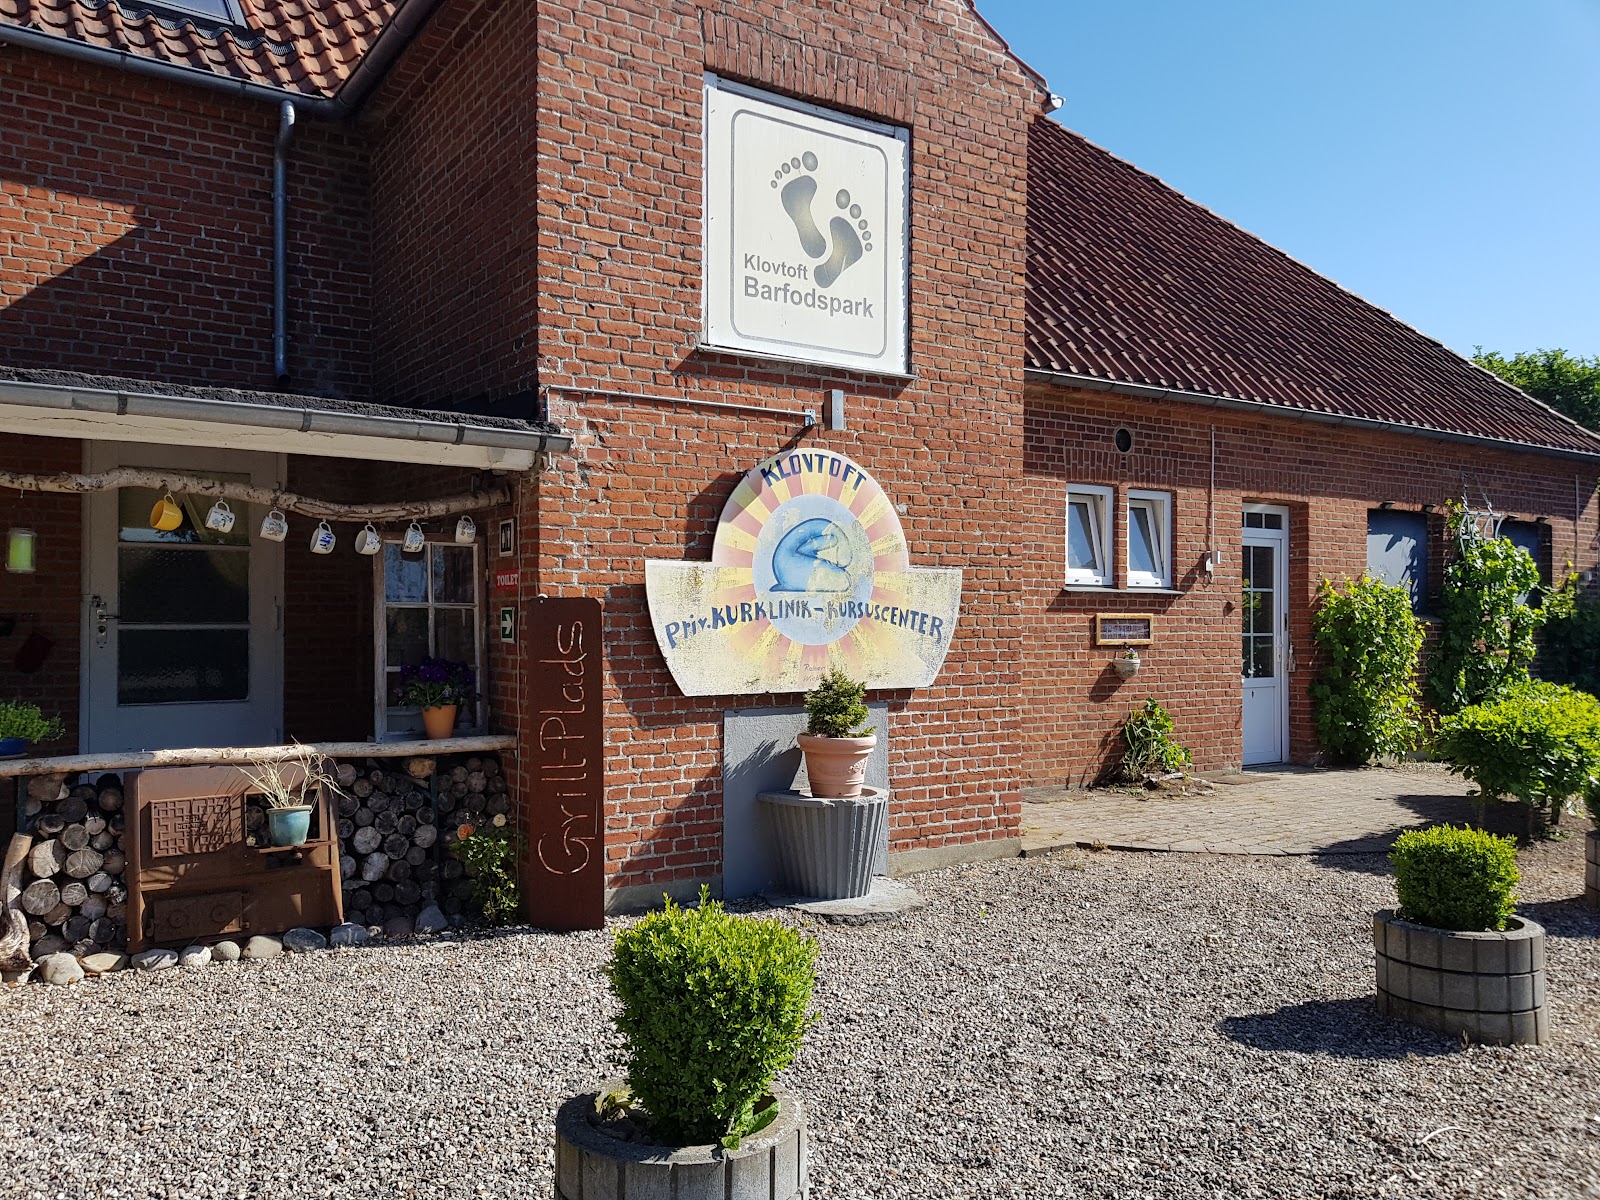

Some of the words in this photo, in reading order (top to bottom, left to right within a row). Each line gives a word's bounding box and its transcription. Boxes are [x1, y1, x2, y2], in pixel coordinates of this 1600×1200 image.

[744, 253, 808, 280] Klovtoft
[744, 275, 874, 318] Barfodspark
[760, 453, 867, 488] KLOVTOFT
[497, 573, 518, 586] TOILET
